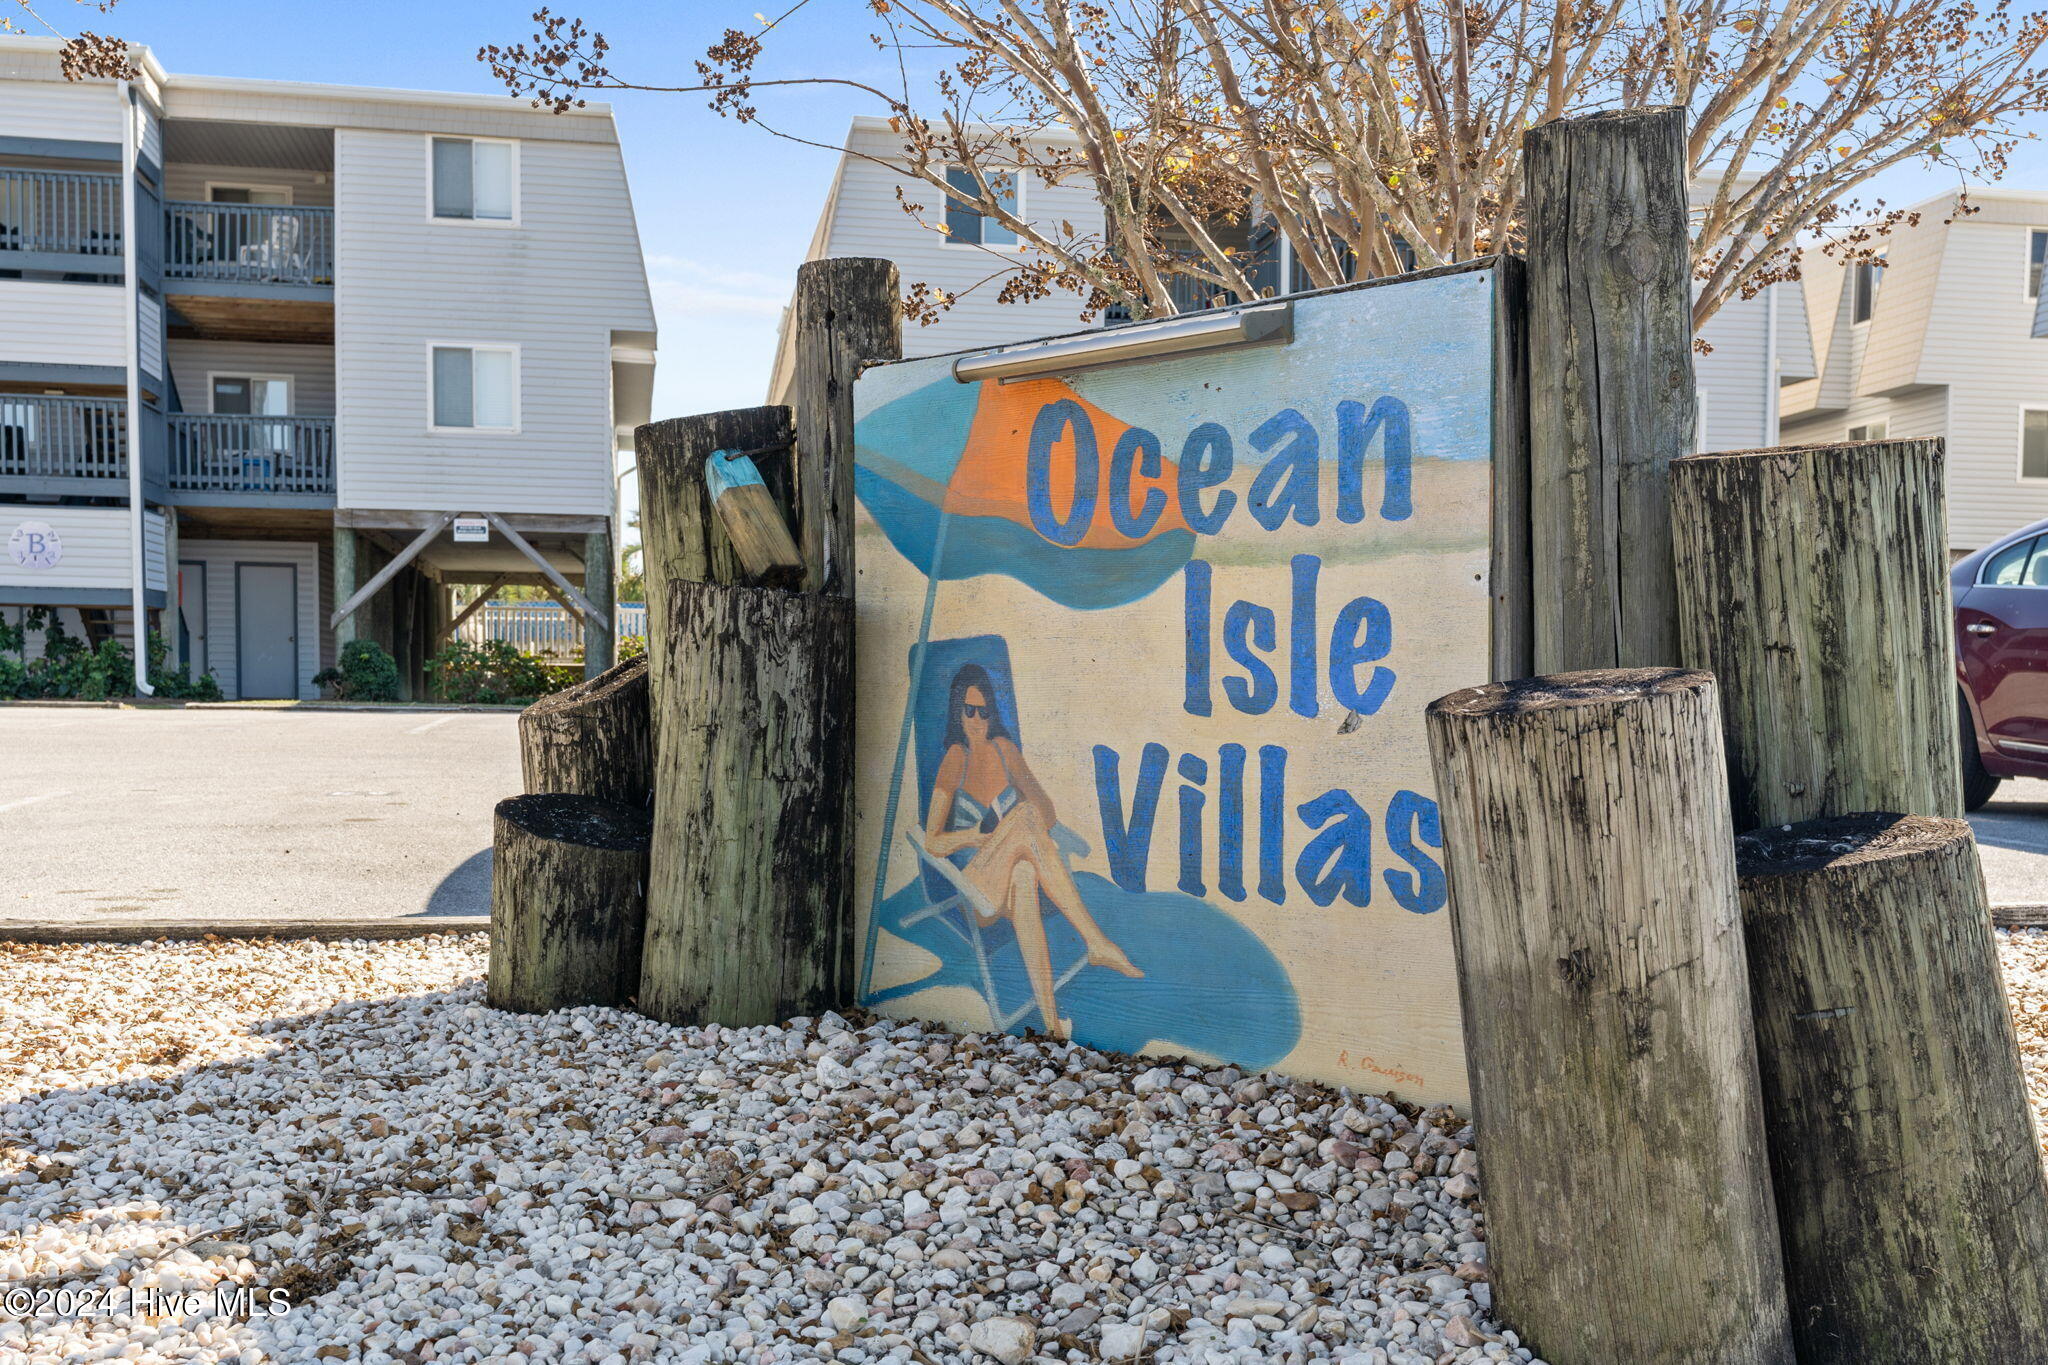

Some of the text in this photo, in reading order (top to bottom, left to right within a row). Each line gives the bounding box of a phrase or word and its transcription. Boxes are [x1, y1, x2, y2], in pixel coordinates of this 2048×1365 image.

[26, 533, 46, 554] B
[1026, 396, 1413, 547] Ocean
[1183, 554, 1397, 719] Isle
[1092, 742, 1448, 915] Villas
